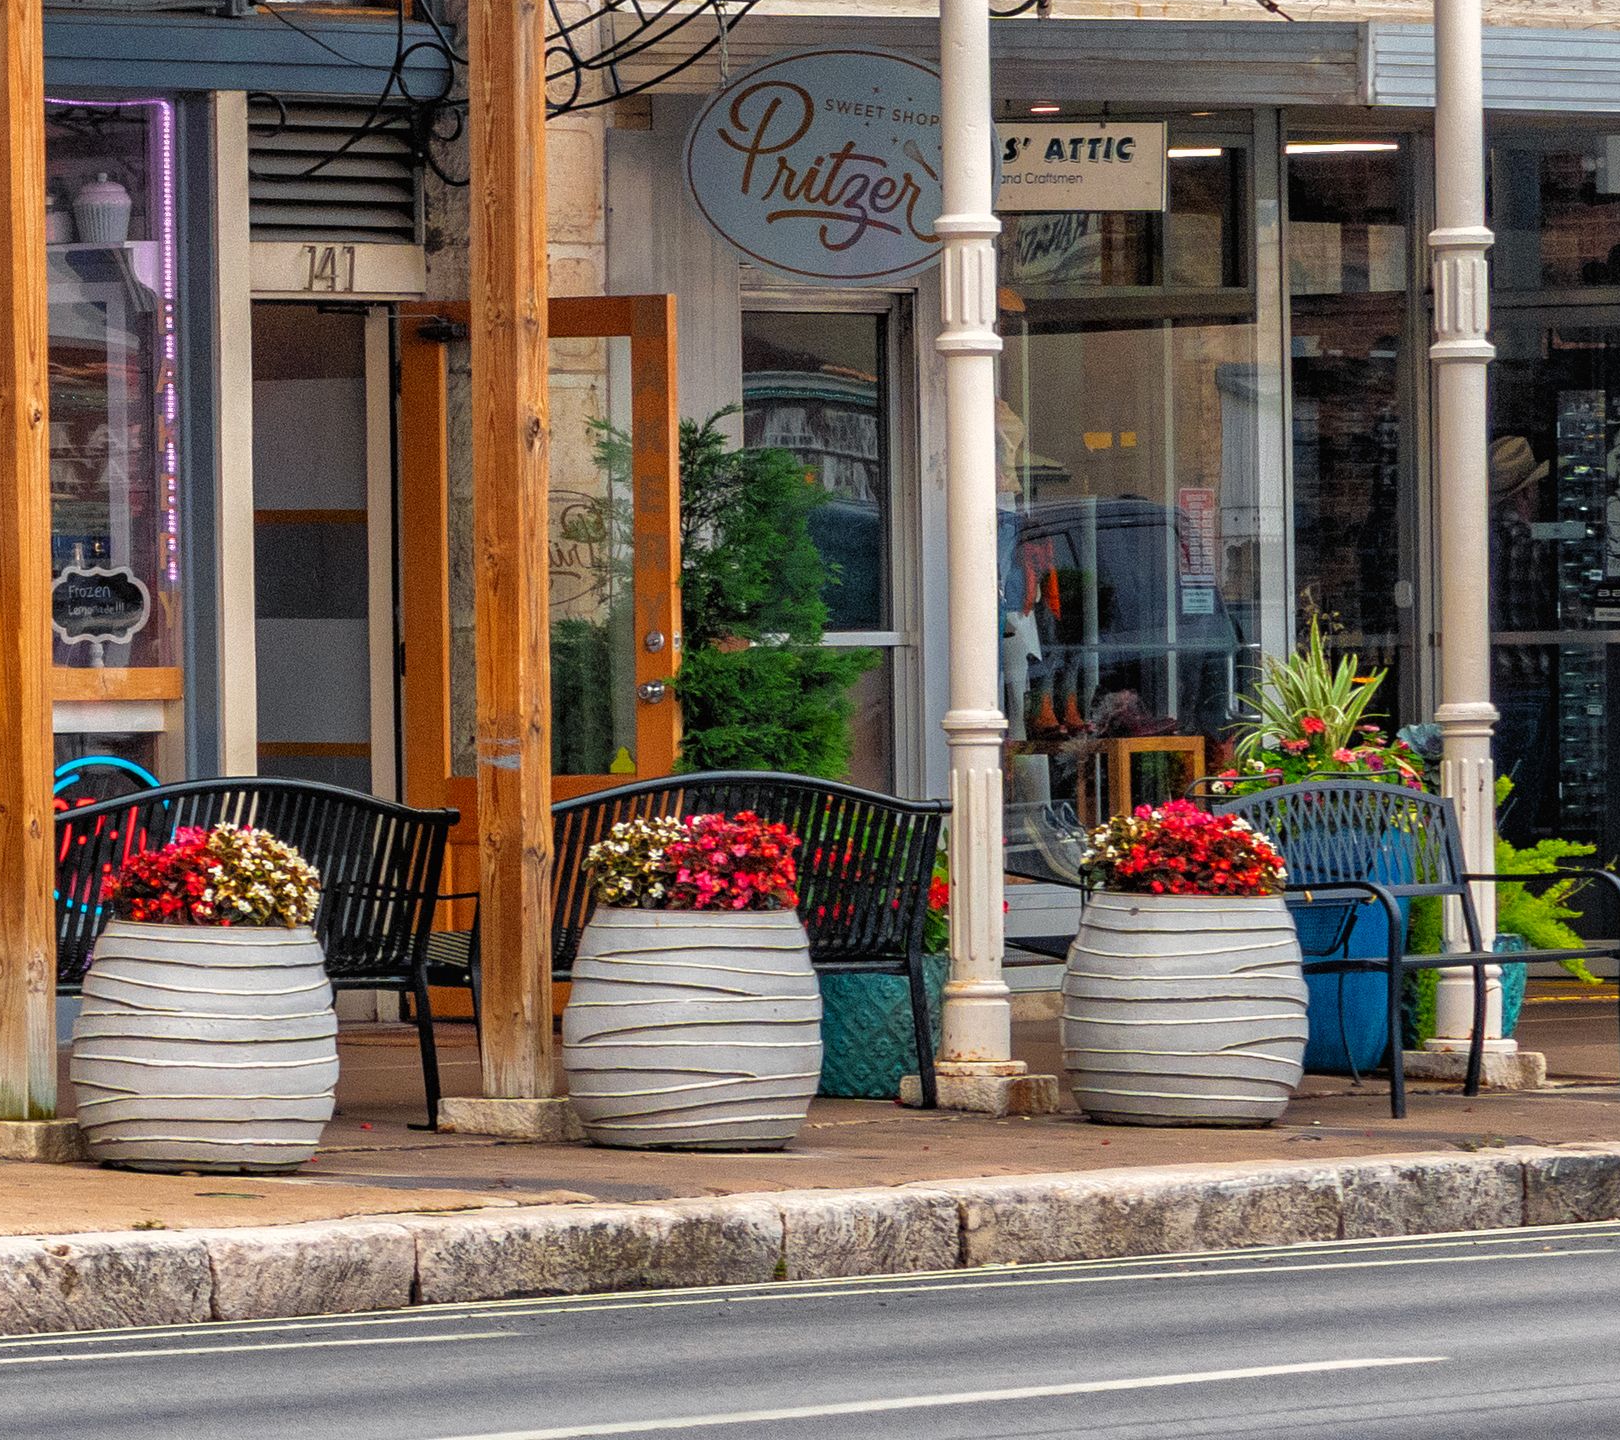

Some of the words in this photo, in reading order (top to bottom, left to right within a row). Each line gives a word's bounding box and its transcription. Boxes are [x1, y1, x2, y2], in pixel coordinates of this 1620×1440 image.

[825, 97, 886, 120] SWEET
[892, 108, 941, 127] SHOP
[1044, 136, 1136, 163] ATTIC
[1025, 172, 1083, 185] Craftsmen
[301, 245, 356, 292] 141
[67, 585, 111, 599] Frozen
